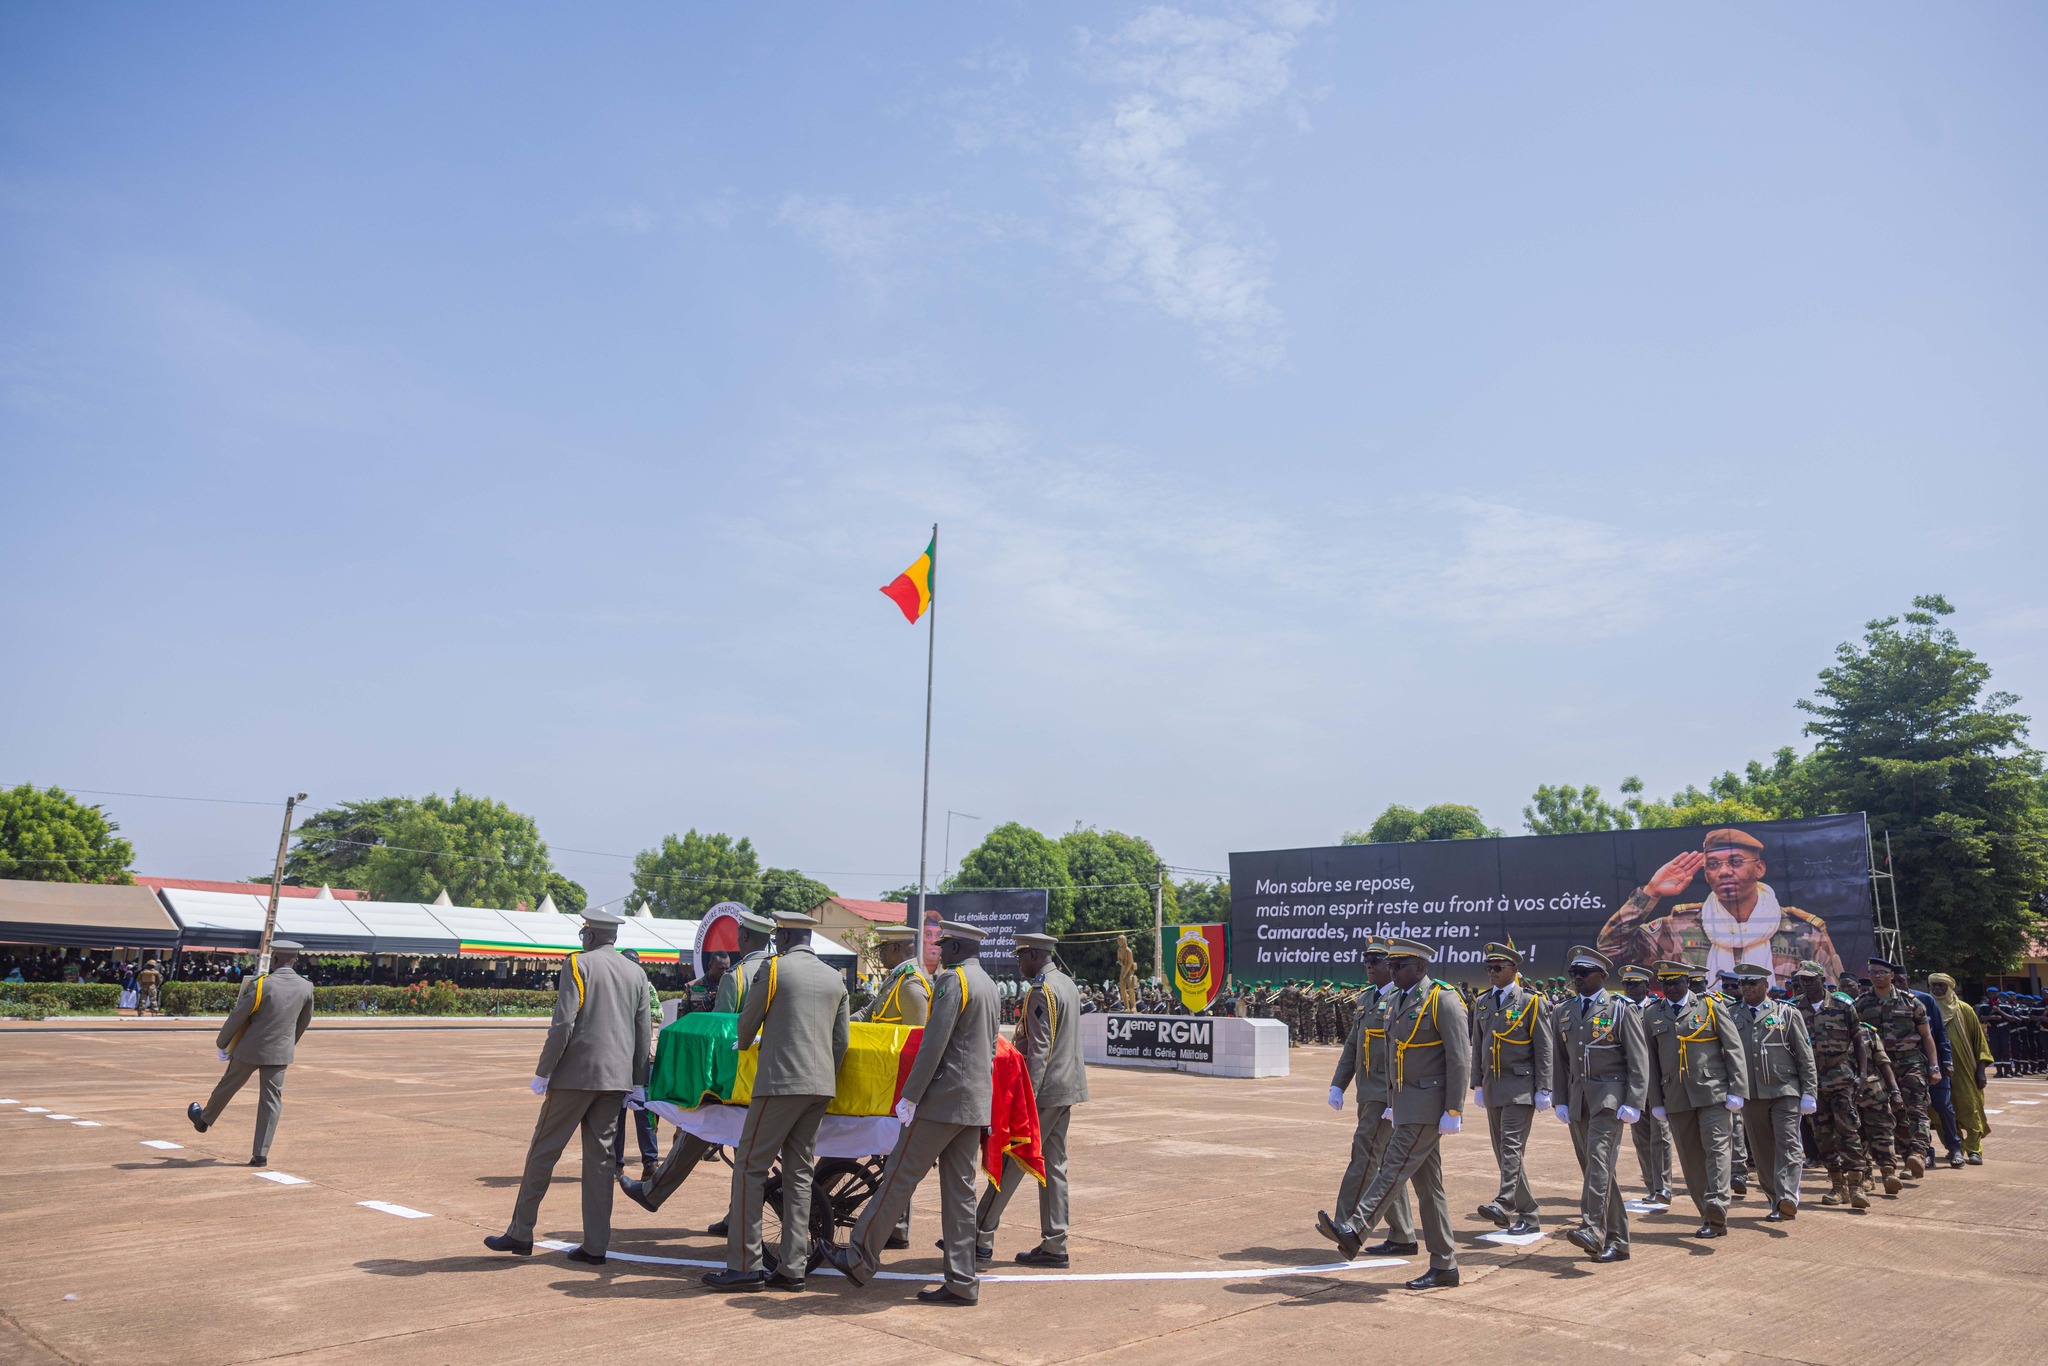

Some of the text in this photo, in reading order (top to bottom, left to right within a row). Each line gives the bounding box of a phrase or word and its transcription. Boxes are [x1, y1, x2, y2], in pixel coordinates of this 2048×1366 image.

[1255, 876, 1415, 895] Mon sabre se repose,
[1256, 891, 1607, 919] mais mon esprit reste au front à vos côtés.
[954, 913, 966, 921] Les
[967, 912, 989, 921] étoiles
[989, 911, 999, 920] de
[1012, 912, 1029, 922] rang
[696, 909, 717, 954] CONSTRUIRE
[718, 905, 740, 918] PARFOIS
[999, 926, 1013, 935] pas
[1257, 922, 1349, 942] Camarades,
[1352, 926, 1372, 938] ne
[1375, 921, 1431, 938] lâchez
[1435, 920, 1470, 937] rien
[994, 949, 1002, 958] la
[1257, 946, 1272, 963] la
[1274, 946, 1330, 963] victoire
[1333, 949, 1358, 963] est
[1158, 1021, 1210, 1045] RGM
[1108, 1044, 1209, 1060] Régiment du Génie Militaire
